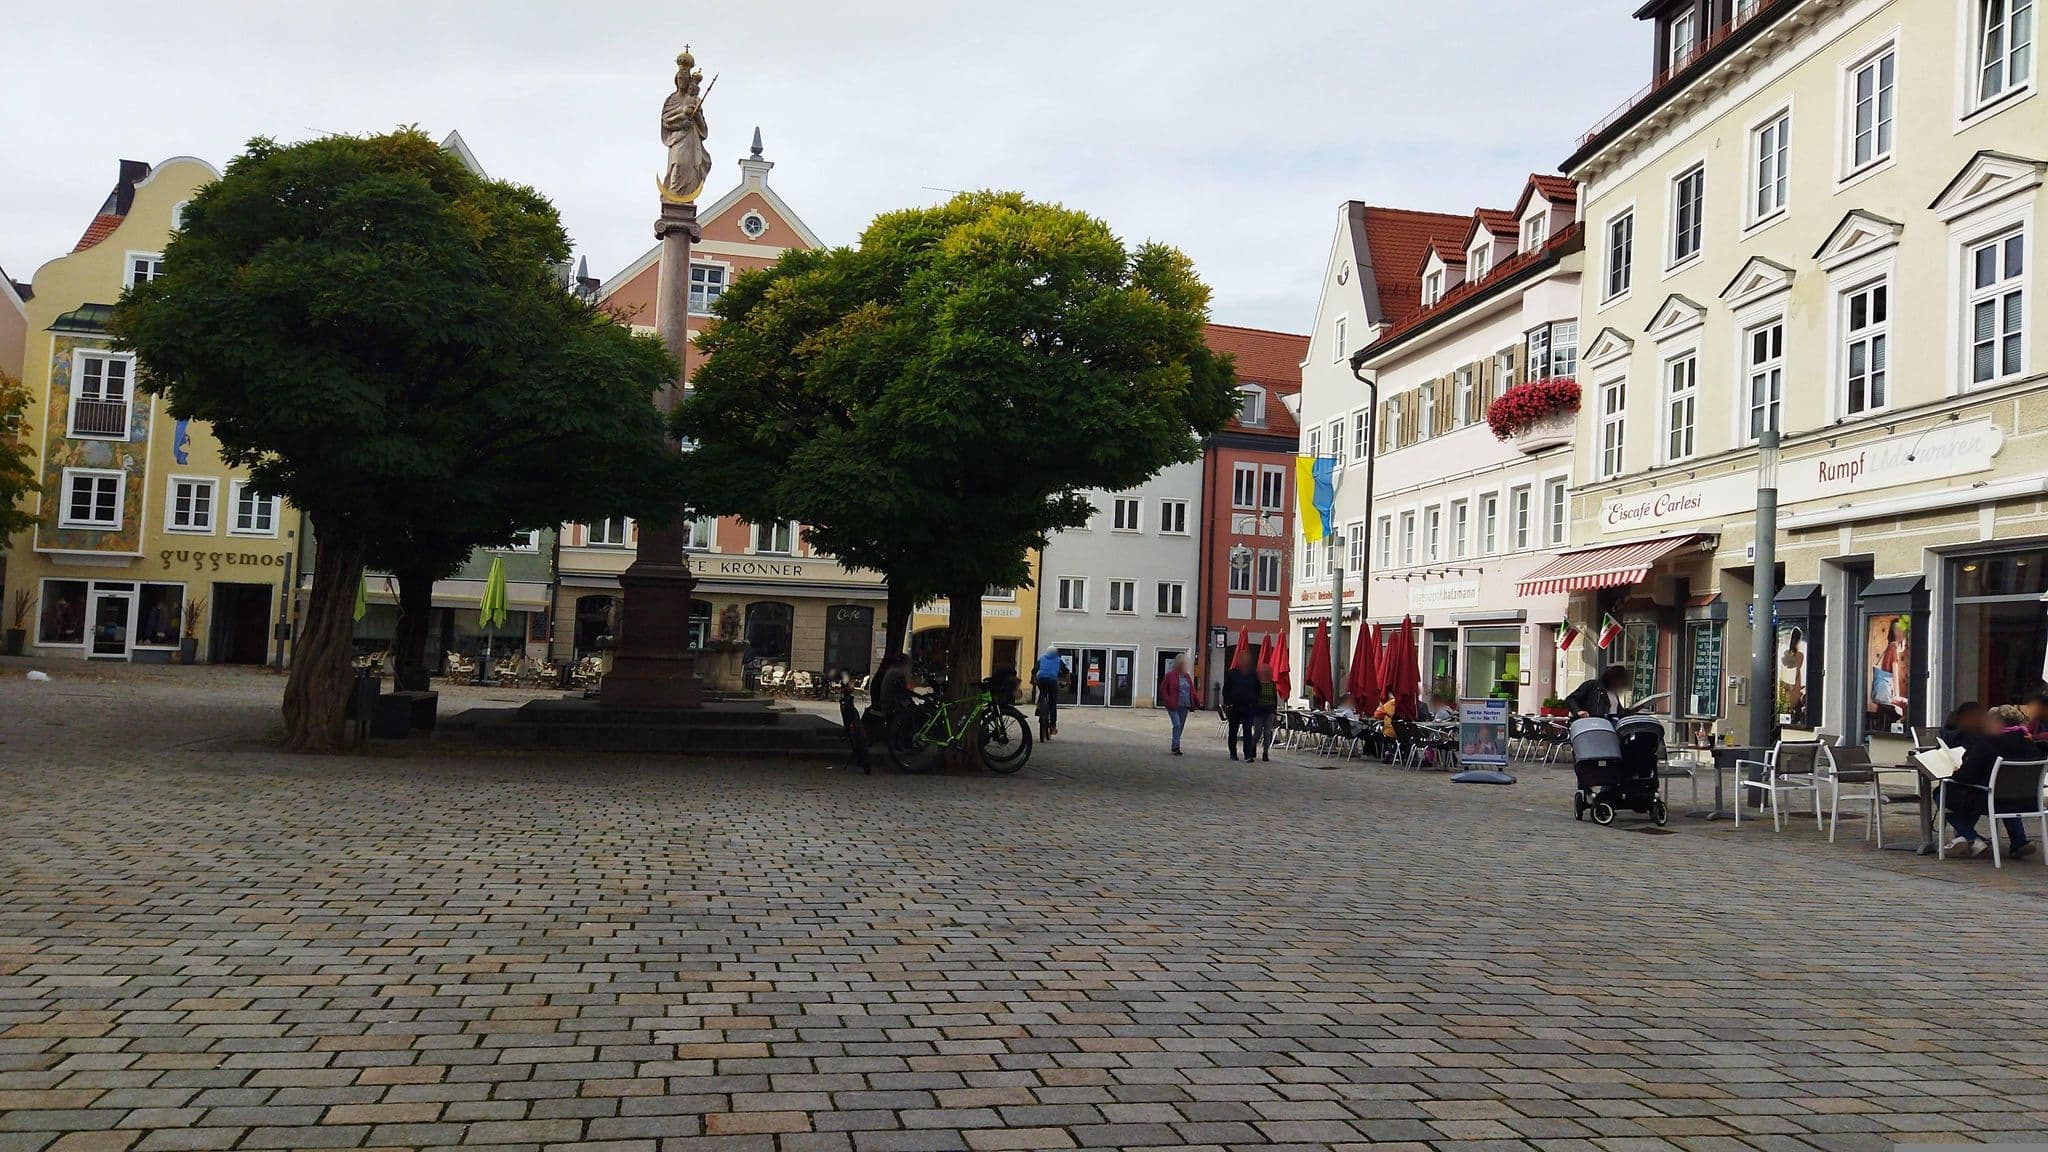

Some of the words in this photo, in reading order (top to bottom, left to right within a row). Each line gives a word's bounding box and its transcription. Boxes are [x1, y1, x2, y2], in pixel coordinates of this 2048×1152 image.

[1819, 451, 1866, 483] Rumpf
[1608, 502, 1651, 525] Eiscafé
[1654, 492, 1702, 517] Carlesi
